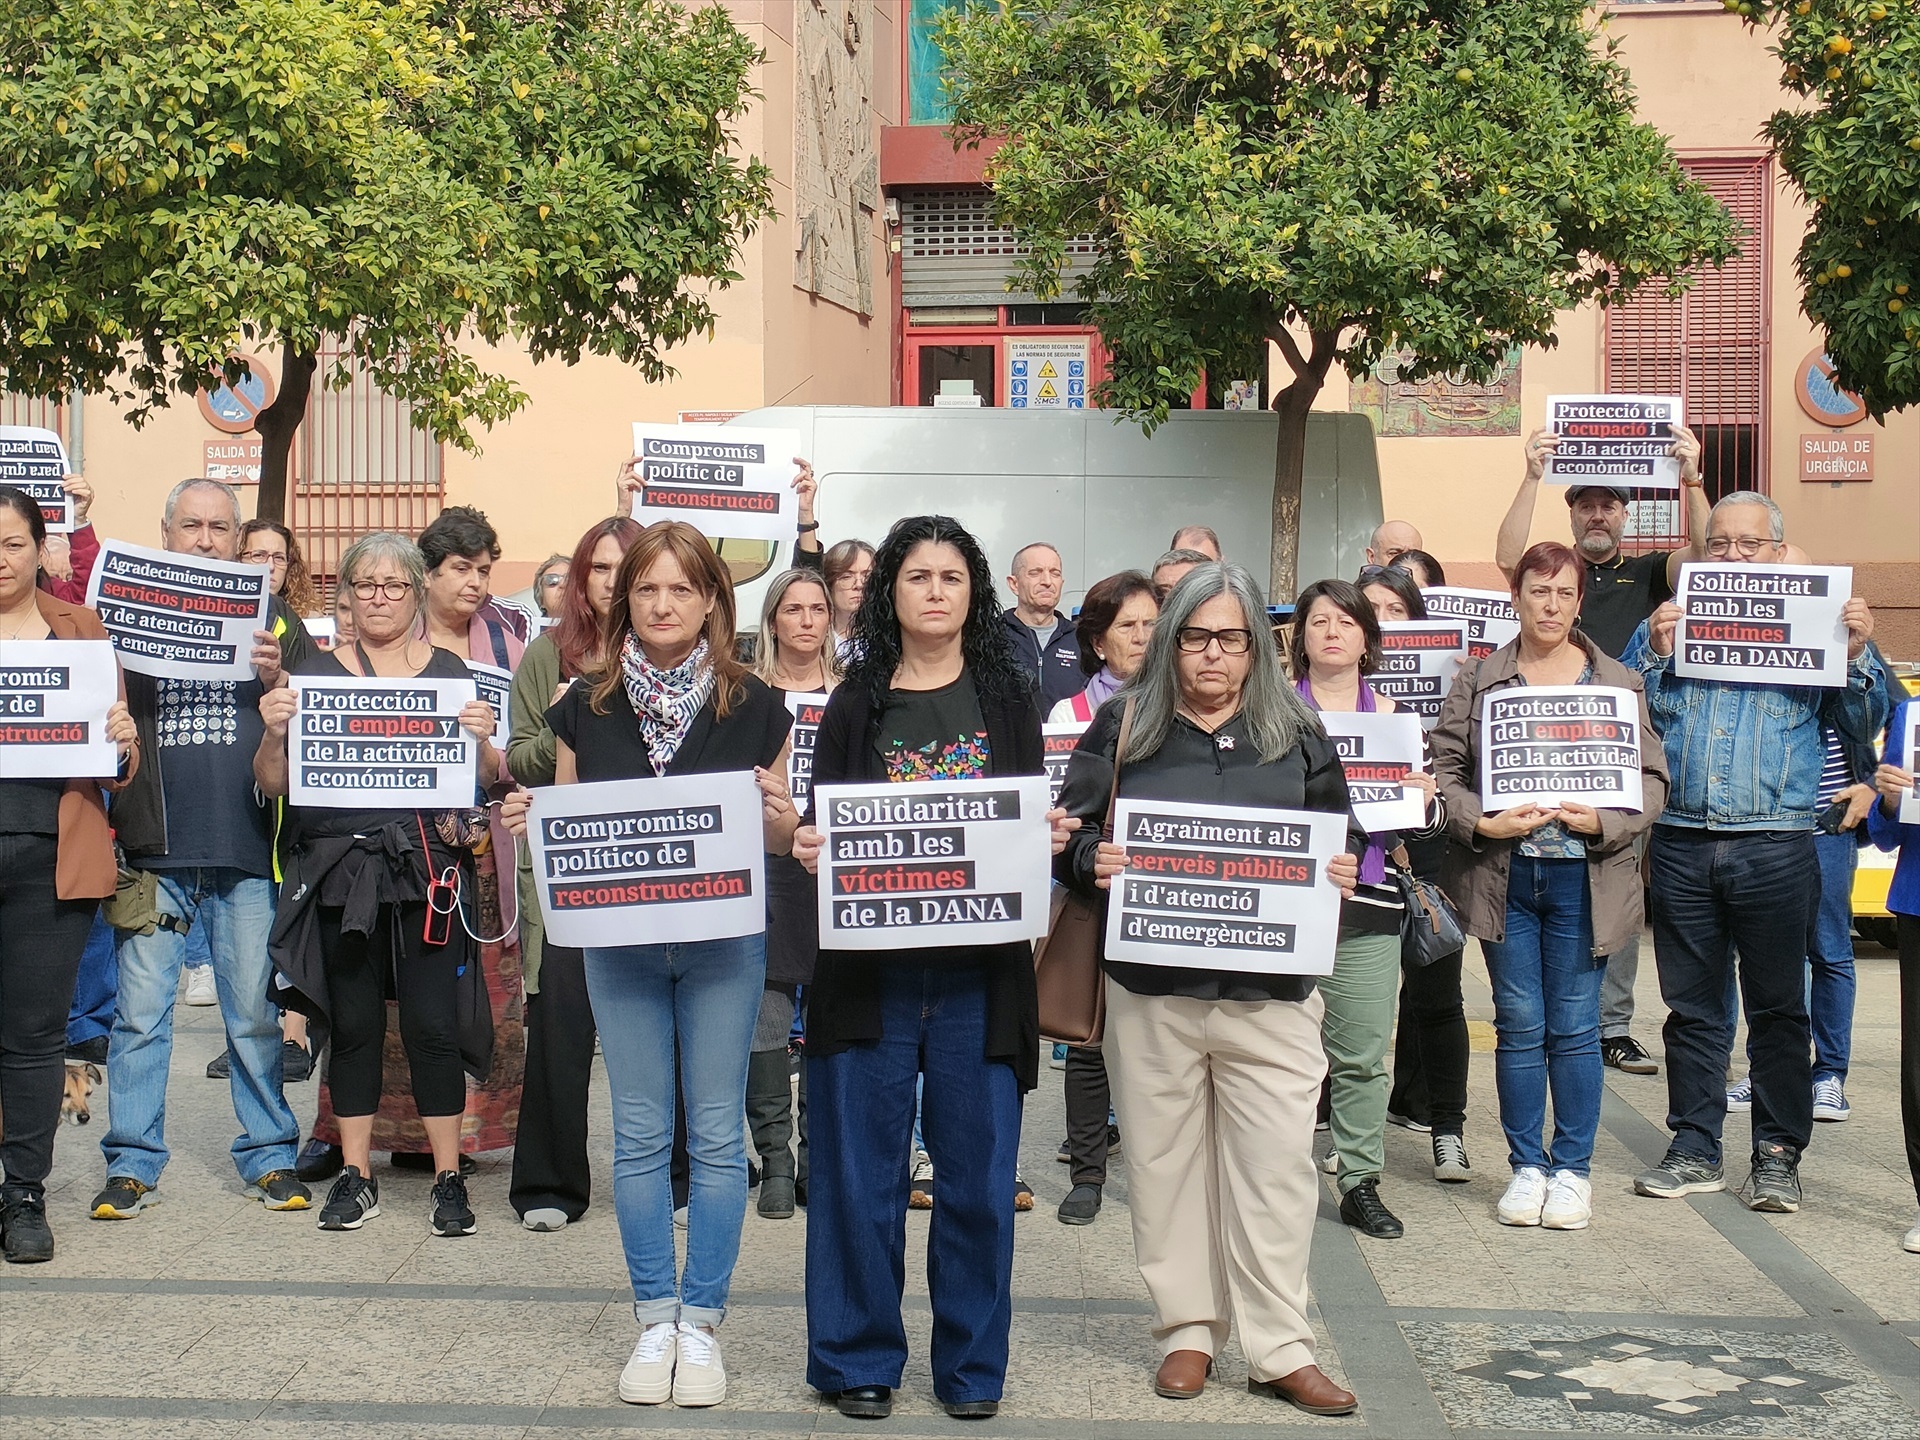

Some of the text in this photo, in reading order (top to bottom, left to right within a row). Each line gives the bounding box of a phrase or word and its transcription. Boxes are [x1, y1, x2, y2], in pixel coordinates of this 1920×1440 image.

[1558, 403, 1666, 419] Protecció de
[1650, 424, 1657, 436] i
[207, 446, 262, 458] SALIDA DE
[648, 440, 758, 460] Compromís
[1557, 442, 1670, 457] de la activitat
[1805, 440, 1870, 453] SALIDA DE
[648, 463, 737, 482] polític de
[1556, 460, 1649, 475] econòmica
[1806, 460, 1868, 474] URGENCIA
[646, 490, 775, 511] reconstrucció
[107, 555, 258, 592] Agradecimiento a los
[1692, 573, 1812, 595] Solidaritat
[103, 581, 255, 616] servicios públicos
[1691, 598, 1776, 618] amb les
[100, 607, 216, 638] y de atención
[1690, 622, 1784, 642] víctimes
[121, 637, 230, 661] emergencias
[1382, 632, 1458, 650] nyament
[1690, 645, 1816, 669] de la DANA
[1380, 679, 1408, 697] qui
[1412, 678, 1434, 692] ho
[10, 695, 36, 713] de
[306, 690, 432, 711] Protección
[1494, 696, 1613, 720] Protección
[307, 715, 455, 739] del empleo y
[1496, 720, 1632, 744] del empleo y
[306, 741, 464, 764] de la actividad
[1496, 746, 1639, 769] de la actividad
[306, 768, 430, 788] económica
[1496, 772, 1618, 792] económica
[836, 796, 998, 824] Solidaritat
[549, 809, 714, 842] Compromiso
[1134, 816, 1302, 847] Agraïment als
[838, 832, 954, 858] amb les
[551, 843, 688, 878] político de
[1131, 854, 1309, 882] serveis públics
[554, 874, 745, 907] reconstrucción
[838, 866, 968, 893] víctimes
[1129, 883, 1253, 911] i d'atenció
[840, 897, 1010, 928] de la DANA
[1127, 917, 1286, 948] d'emergències
